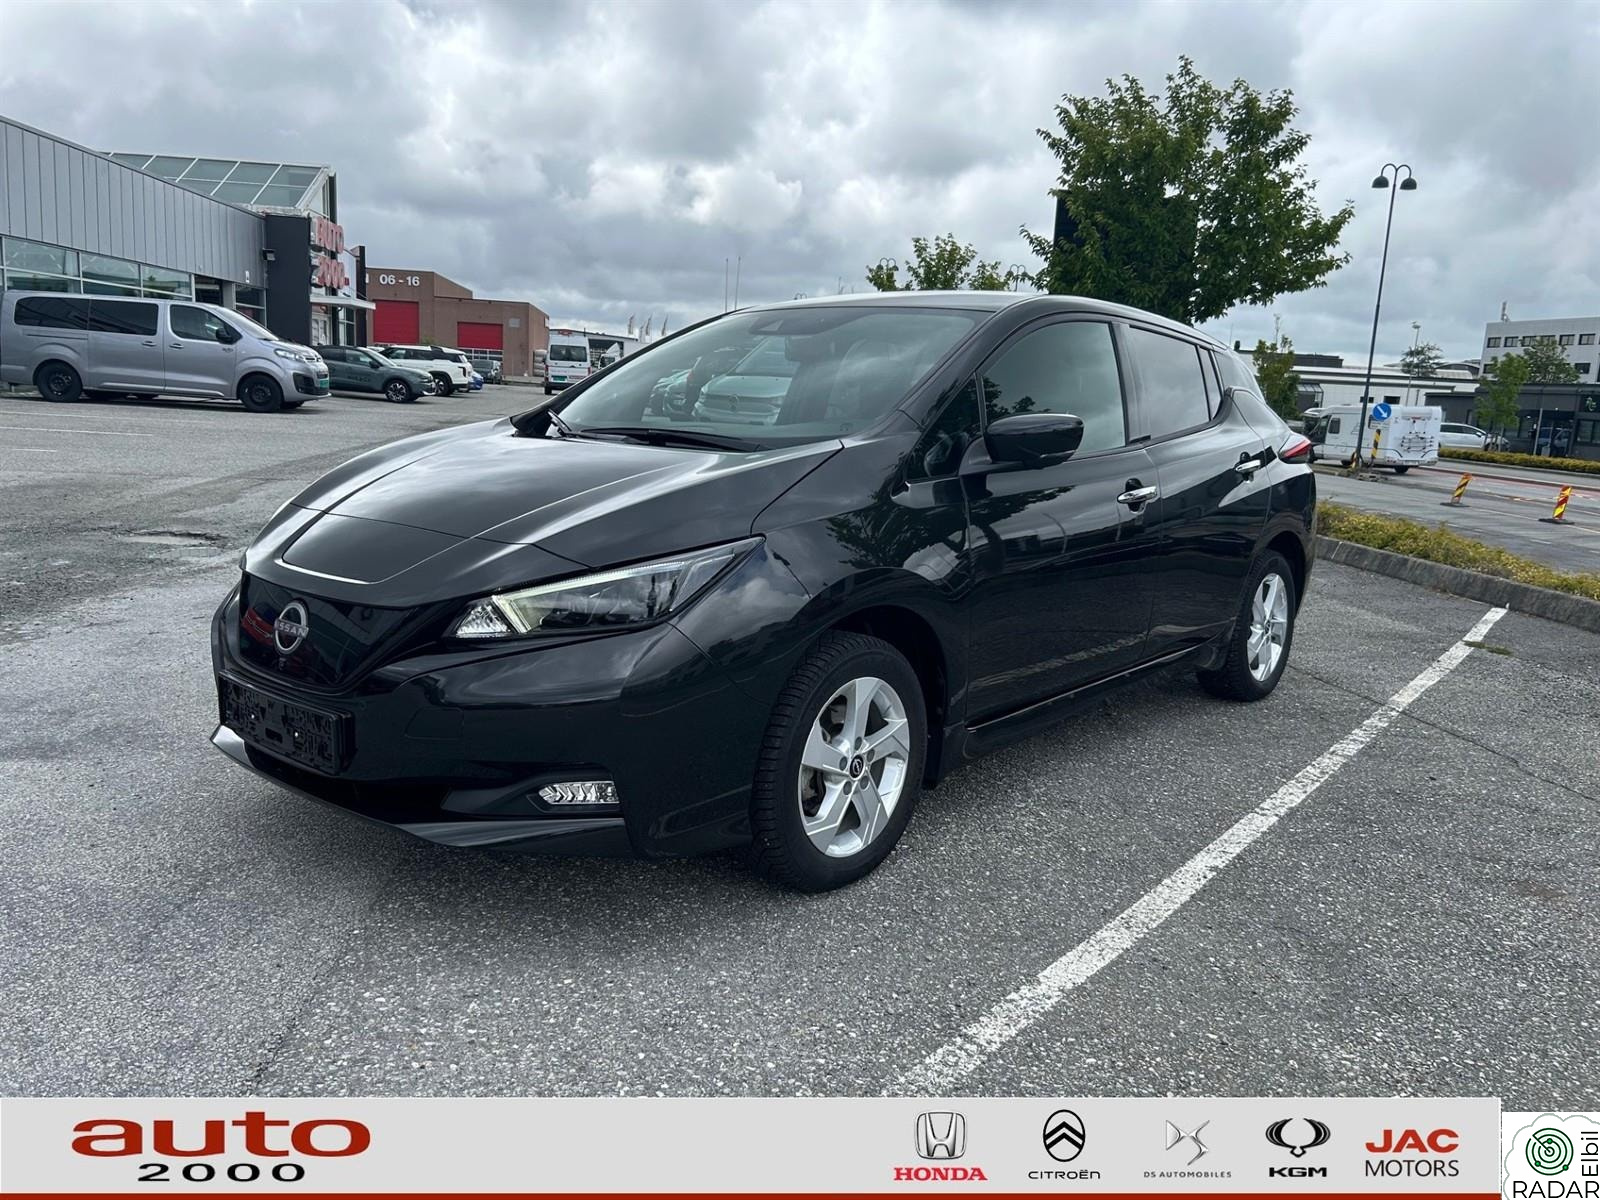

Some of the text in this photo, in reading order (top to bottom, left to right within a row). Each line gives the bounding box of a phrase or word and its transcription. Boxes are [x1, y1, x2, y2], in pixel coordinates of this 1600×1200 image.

[316, 216, 344, 254] AUTO
[379, 274, 396, 285] 06
[406, 275, 420, 287] 16
[275, 619, 308, 638] SSAN
